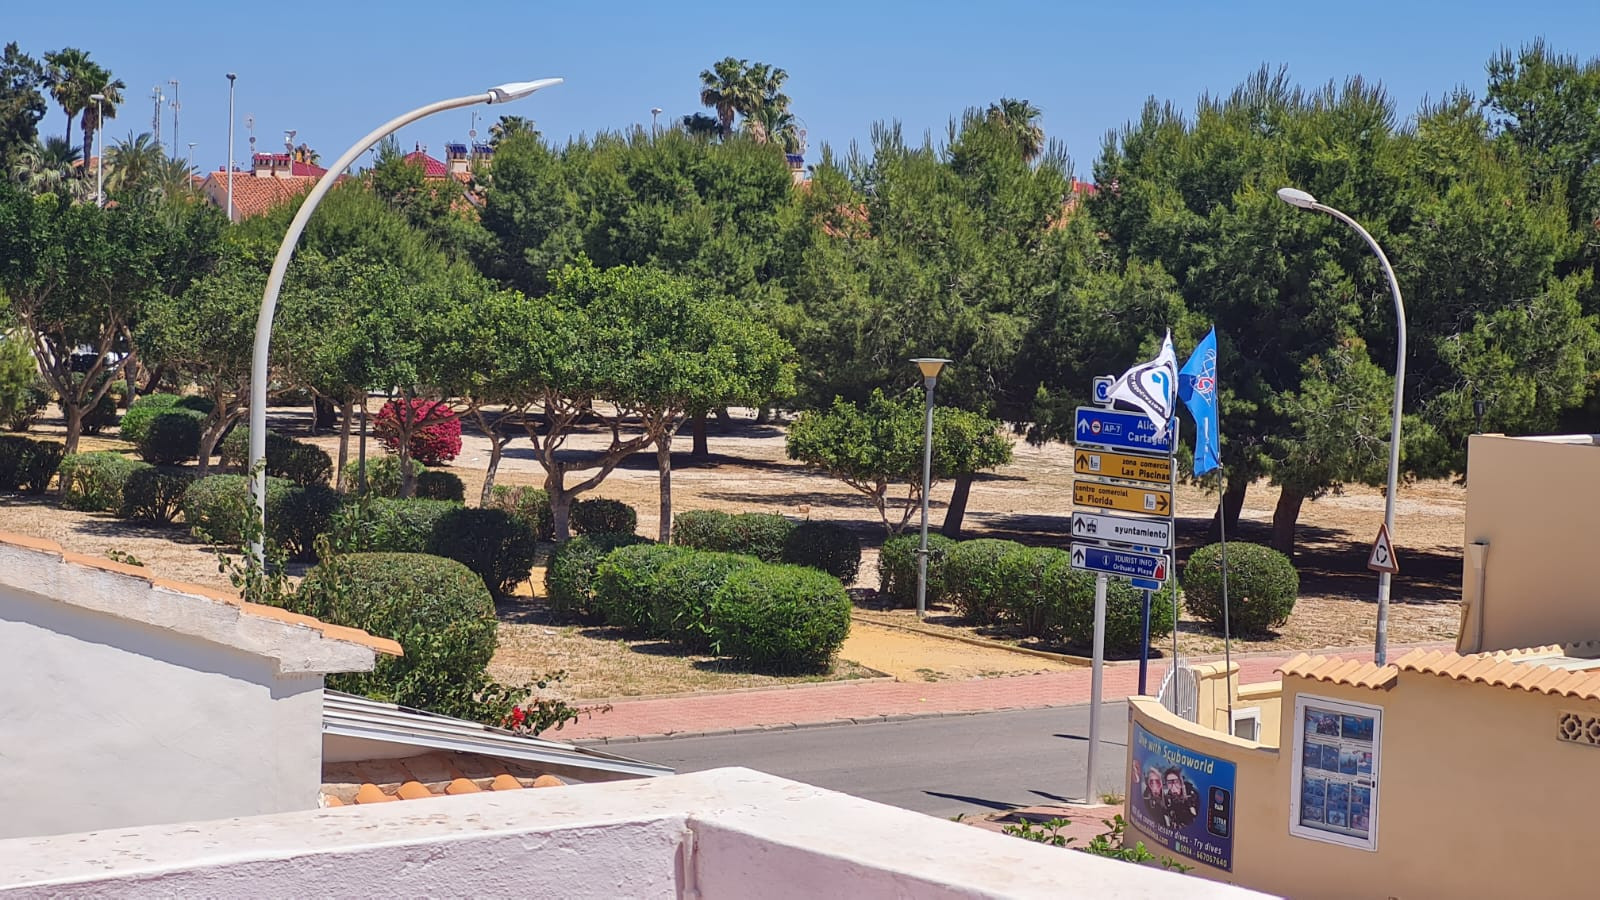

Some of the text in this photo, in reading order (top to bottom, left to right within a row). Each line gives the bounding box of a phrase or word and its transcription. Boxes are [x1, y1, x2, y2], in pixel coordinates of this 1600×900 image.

[1104, 424, 1120, 433] AP-7
[1121, 466, 1170, 480] Las Piscinas
[1098, 487, 1128, 497] comercial
[1075, 493, 1113, 506] La Florida
[1114, 525, 1167, 539] ayuntamiento
[1114, 554, 1153, 567] TOURIST INFO
[1163, 745, 1214, 774] Scubaworld
[1194, 838, 1203, 850] Try
[1204, 842, 1222, 855] dives
